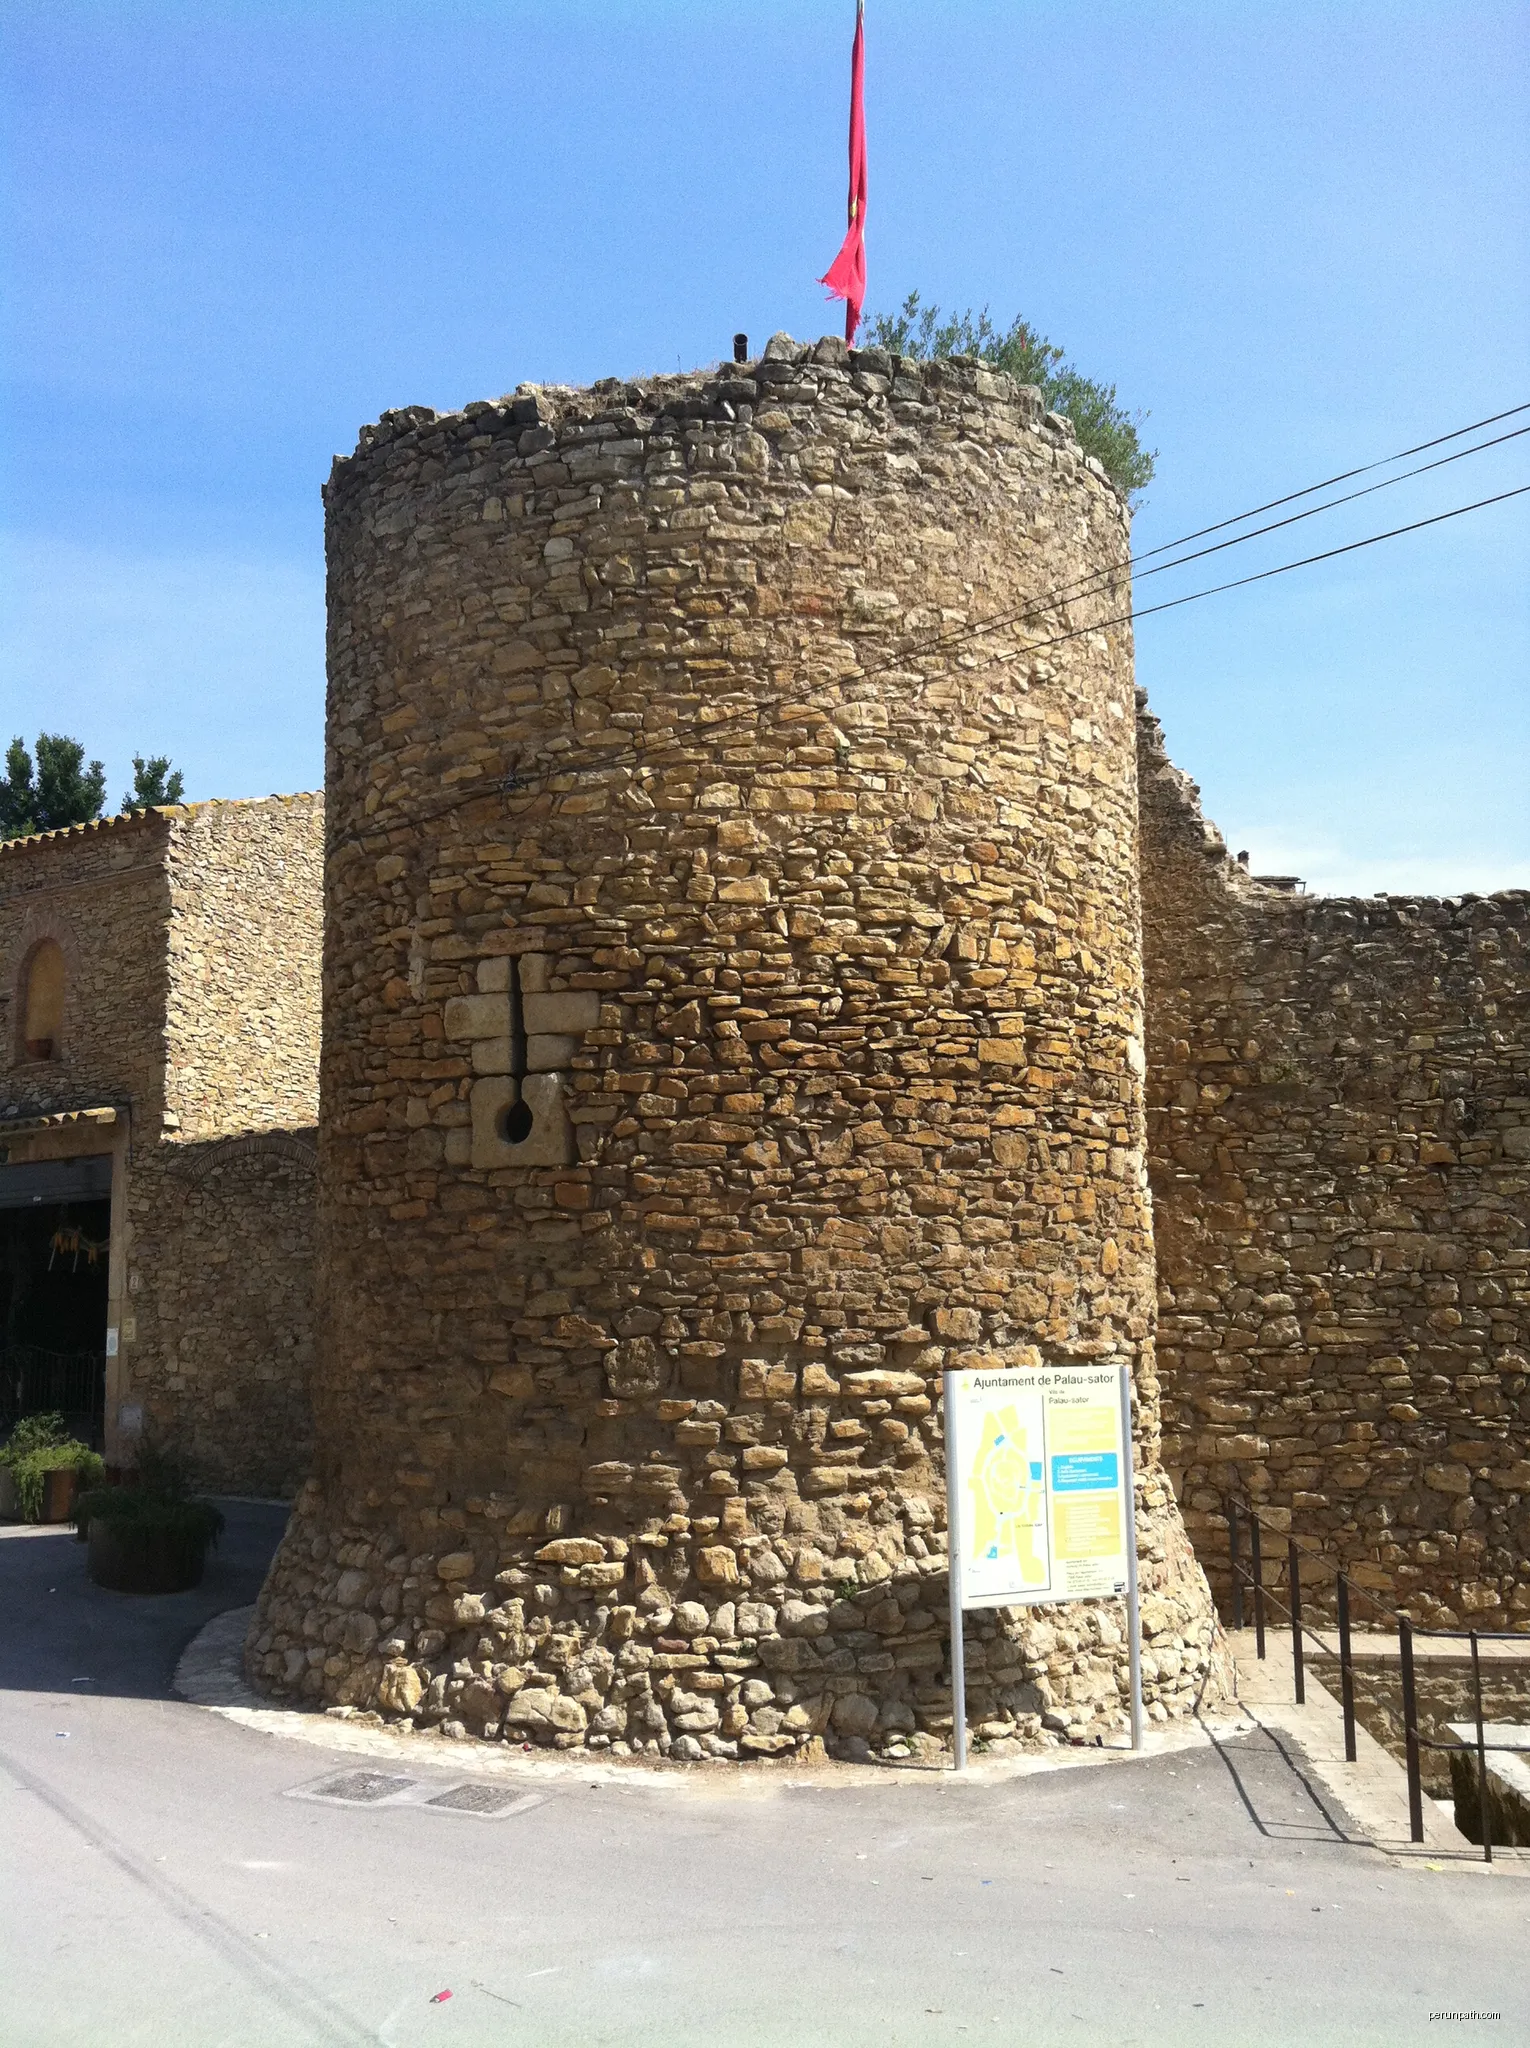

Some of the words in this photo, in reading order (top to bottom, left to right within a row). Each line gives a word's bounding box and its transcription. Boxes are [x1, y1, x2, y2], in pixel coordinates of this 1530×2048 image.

[973, 1376, 1035, 1390] Ajuntament
[1038, 1375, 1051, 1386] de
[1054, 1373, 1114, 1384] Palau-sator
[1049, 1396, 1089, 1405] Palau-sator
